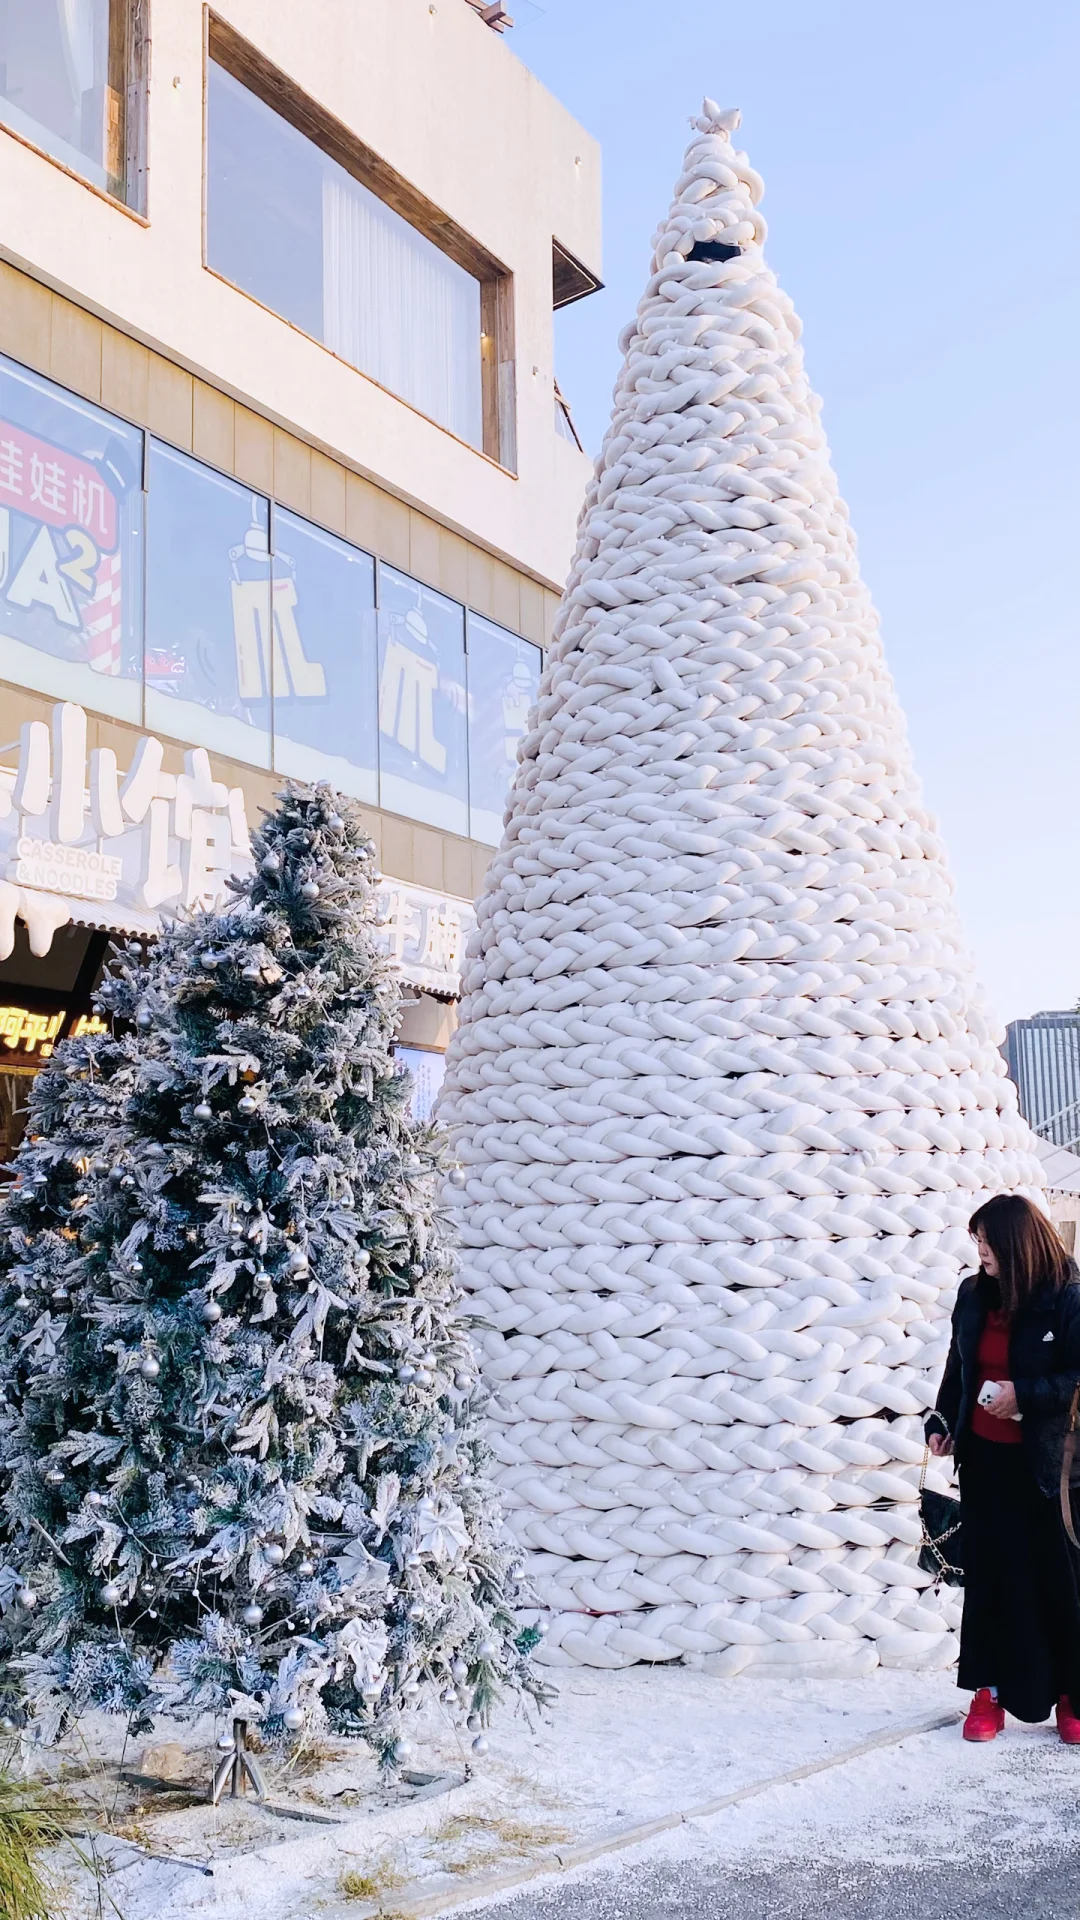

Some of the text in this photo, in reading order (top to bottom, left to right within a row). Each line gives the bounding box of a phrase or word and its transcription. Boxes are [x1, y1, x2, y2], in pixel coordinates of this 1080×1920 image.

[19, 838, 121, 877] CASSEROLE
[19, 863, 116, 898] & NOODLES
